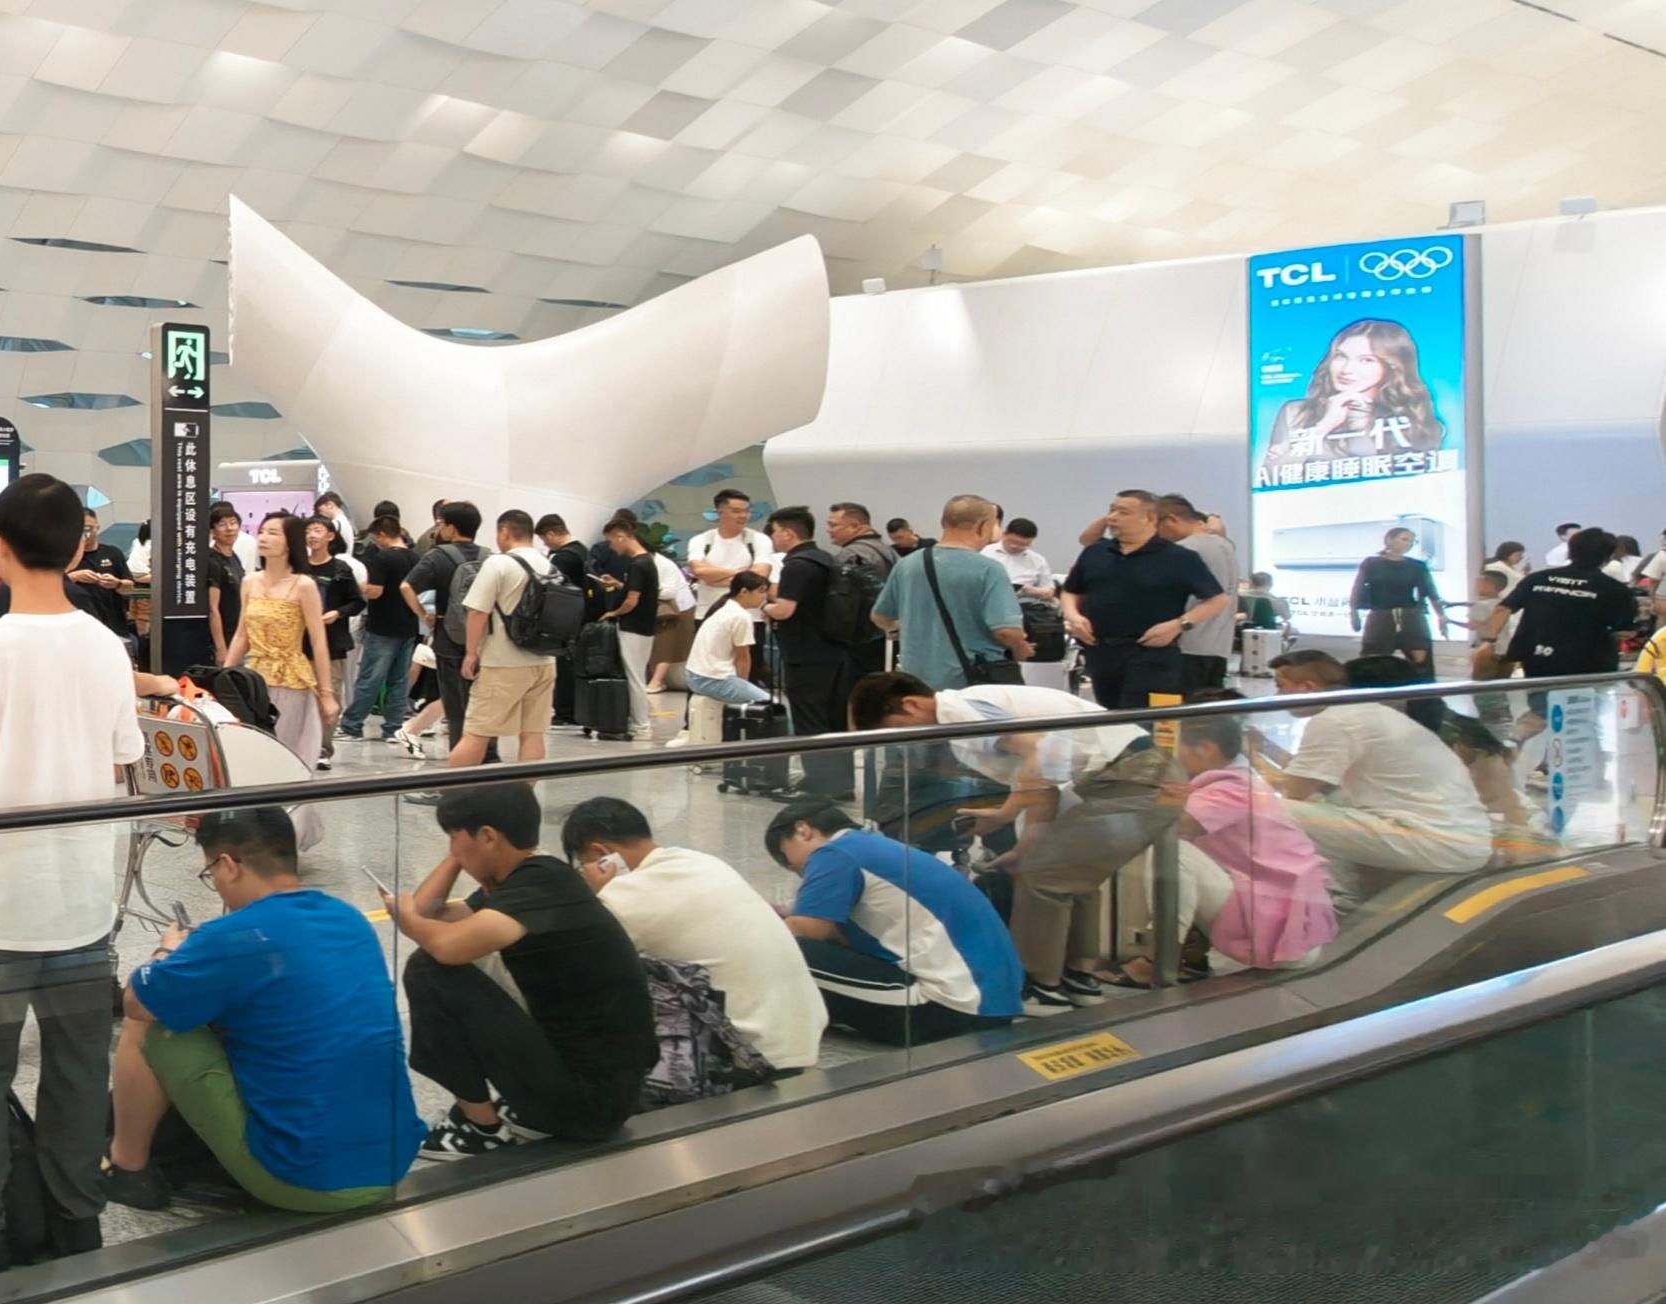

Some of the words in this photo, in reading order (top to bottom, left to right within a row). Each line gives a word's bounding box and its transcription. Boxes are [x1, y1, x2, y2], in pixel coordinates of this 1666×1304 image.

[1256, 261, 1336, 288] TCL
[1289, 415, 1412, 456] 新一代
[248, 468, 283, 484] TCL
[1256, 449, 1459, 486] AI健康睡眠空调
[185, 441, 197, 604] 此休息区设有充电装置
